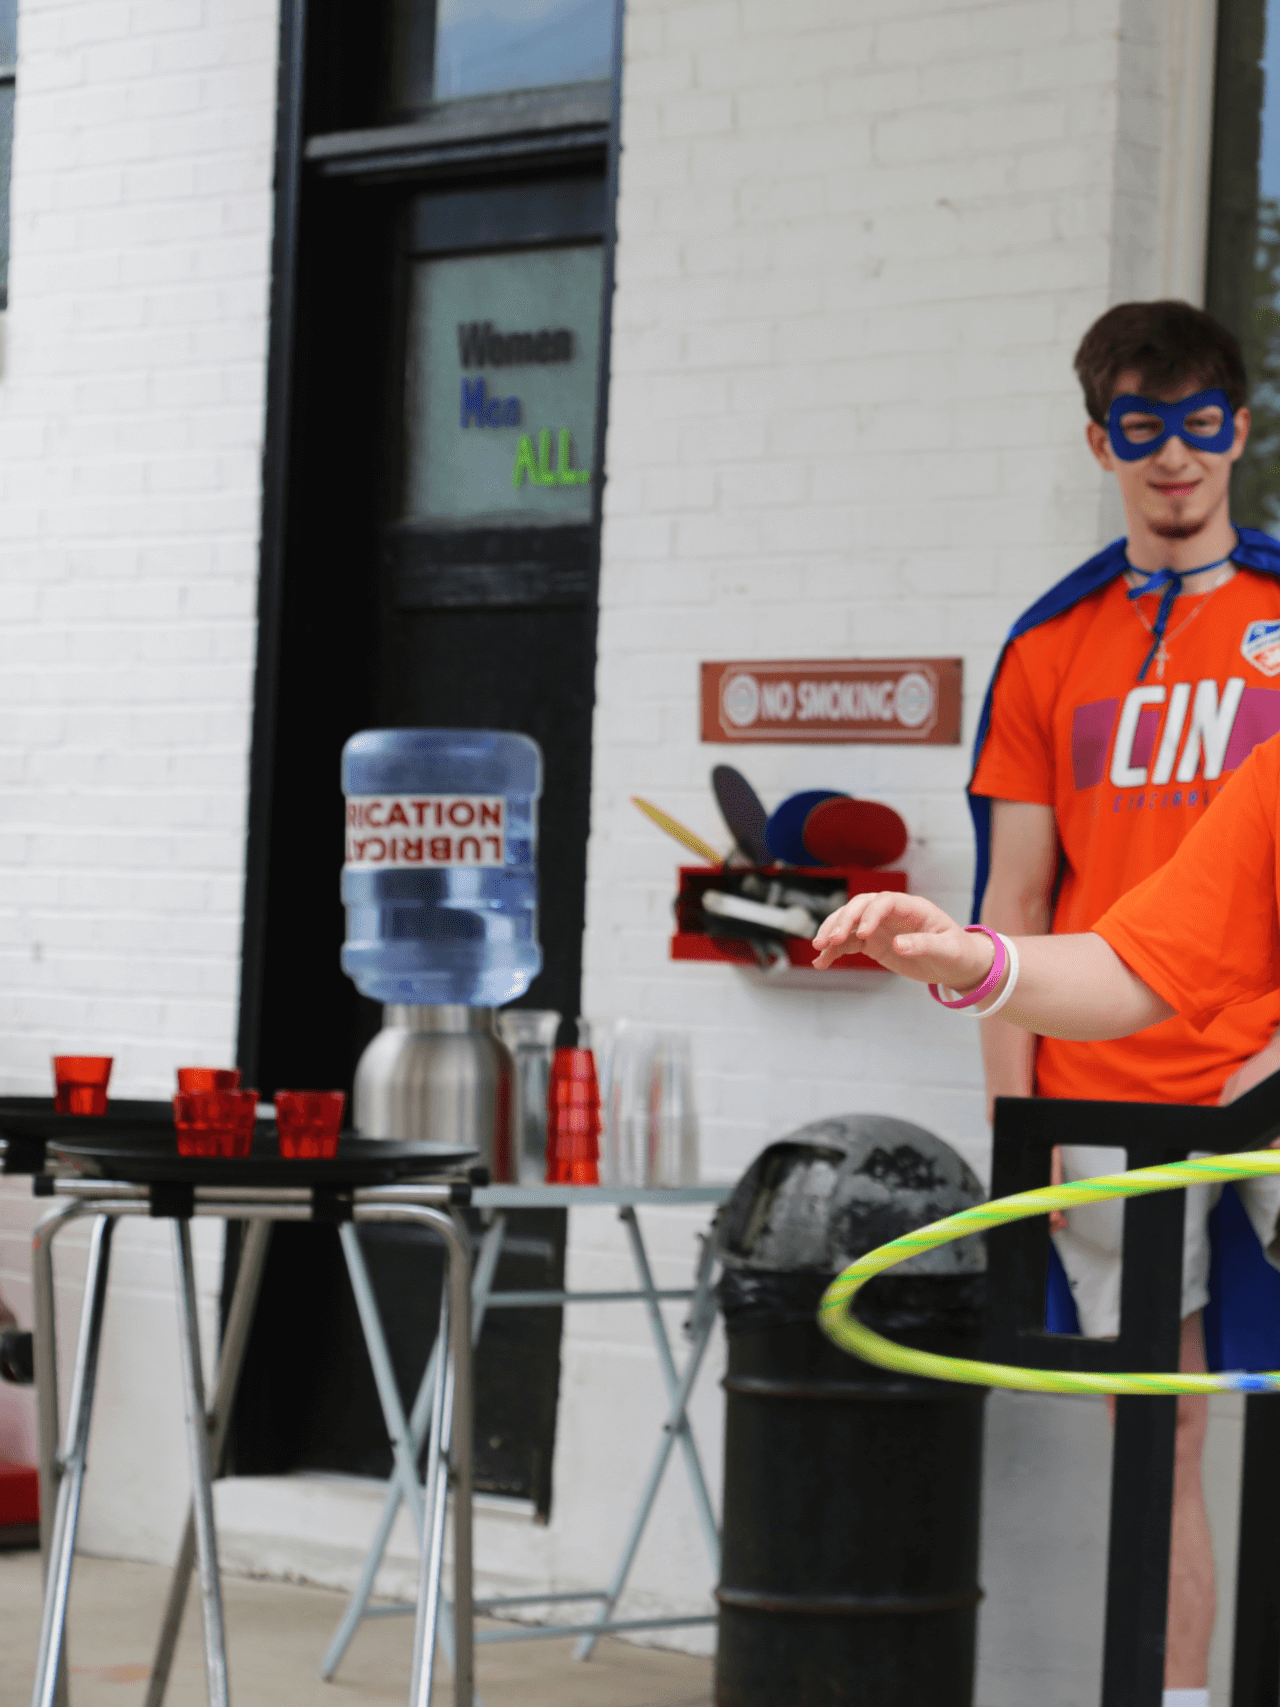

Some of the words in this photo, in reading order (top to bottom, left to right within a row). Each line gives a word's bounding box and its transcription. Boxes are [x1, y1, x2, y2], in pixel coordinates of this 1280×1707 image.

[761, 682, 794, 721] NO
[797, 681, 896, 721] SMOKING
[1110, 676, 1246, 788] CIN
